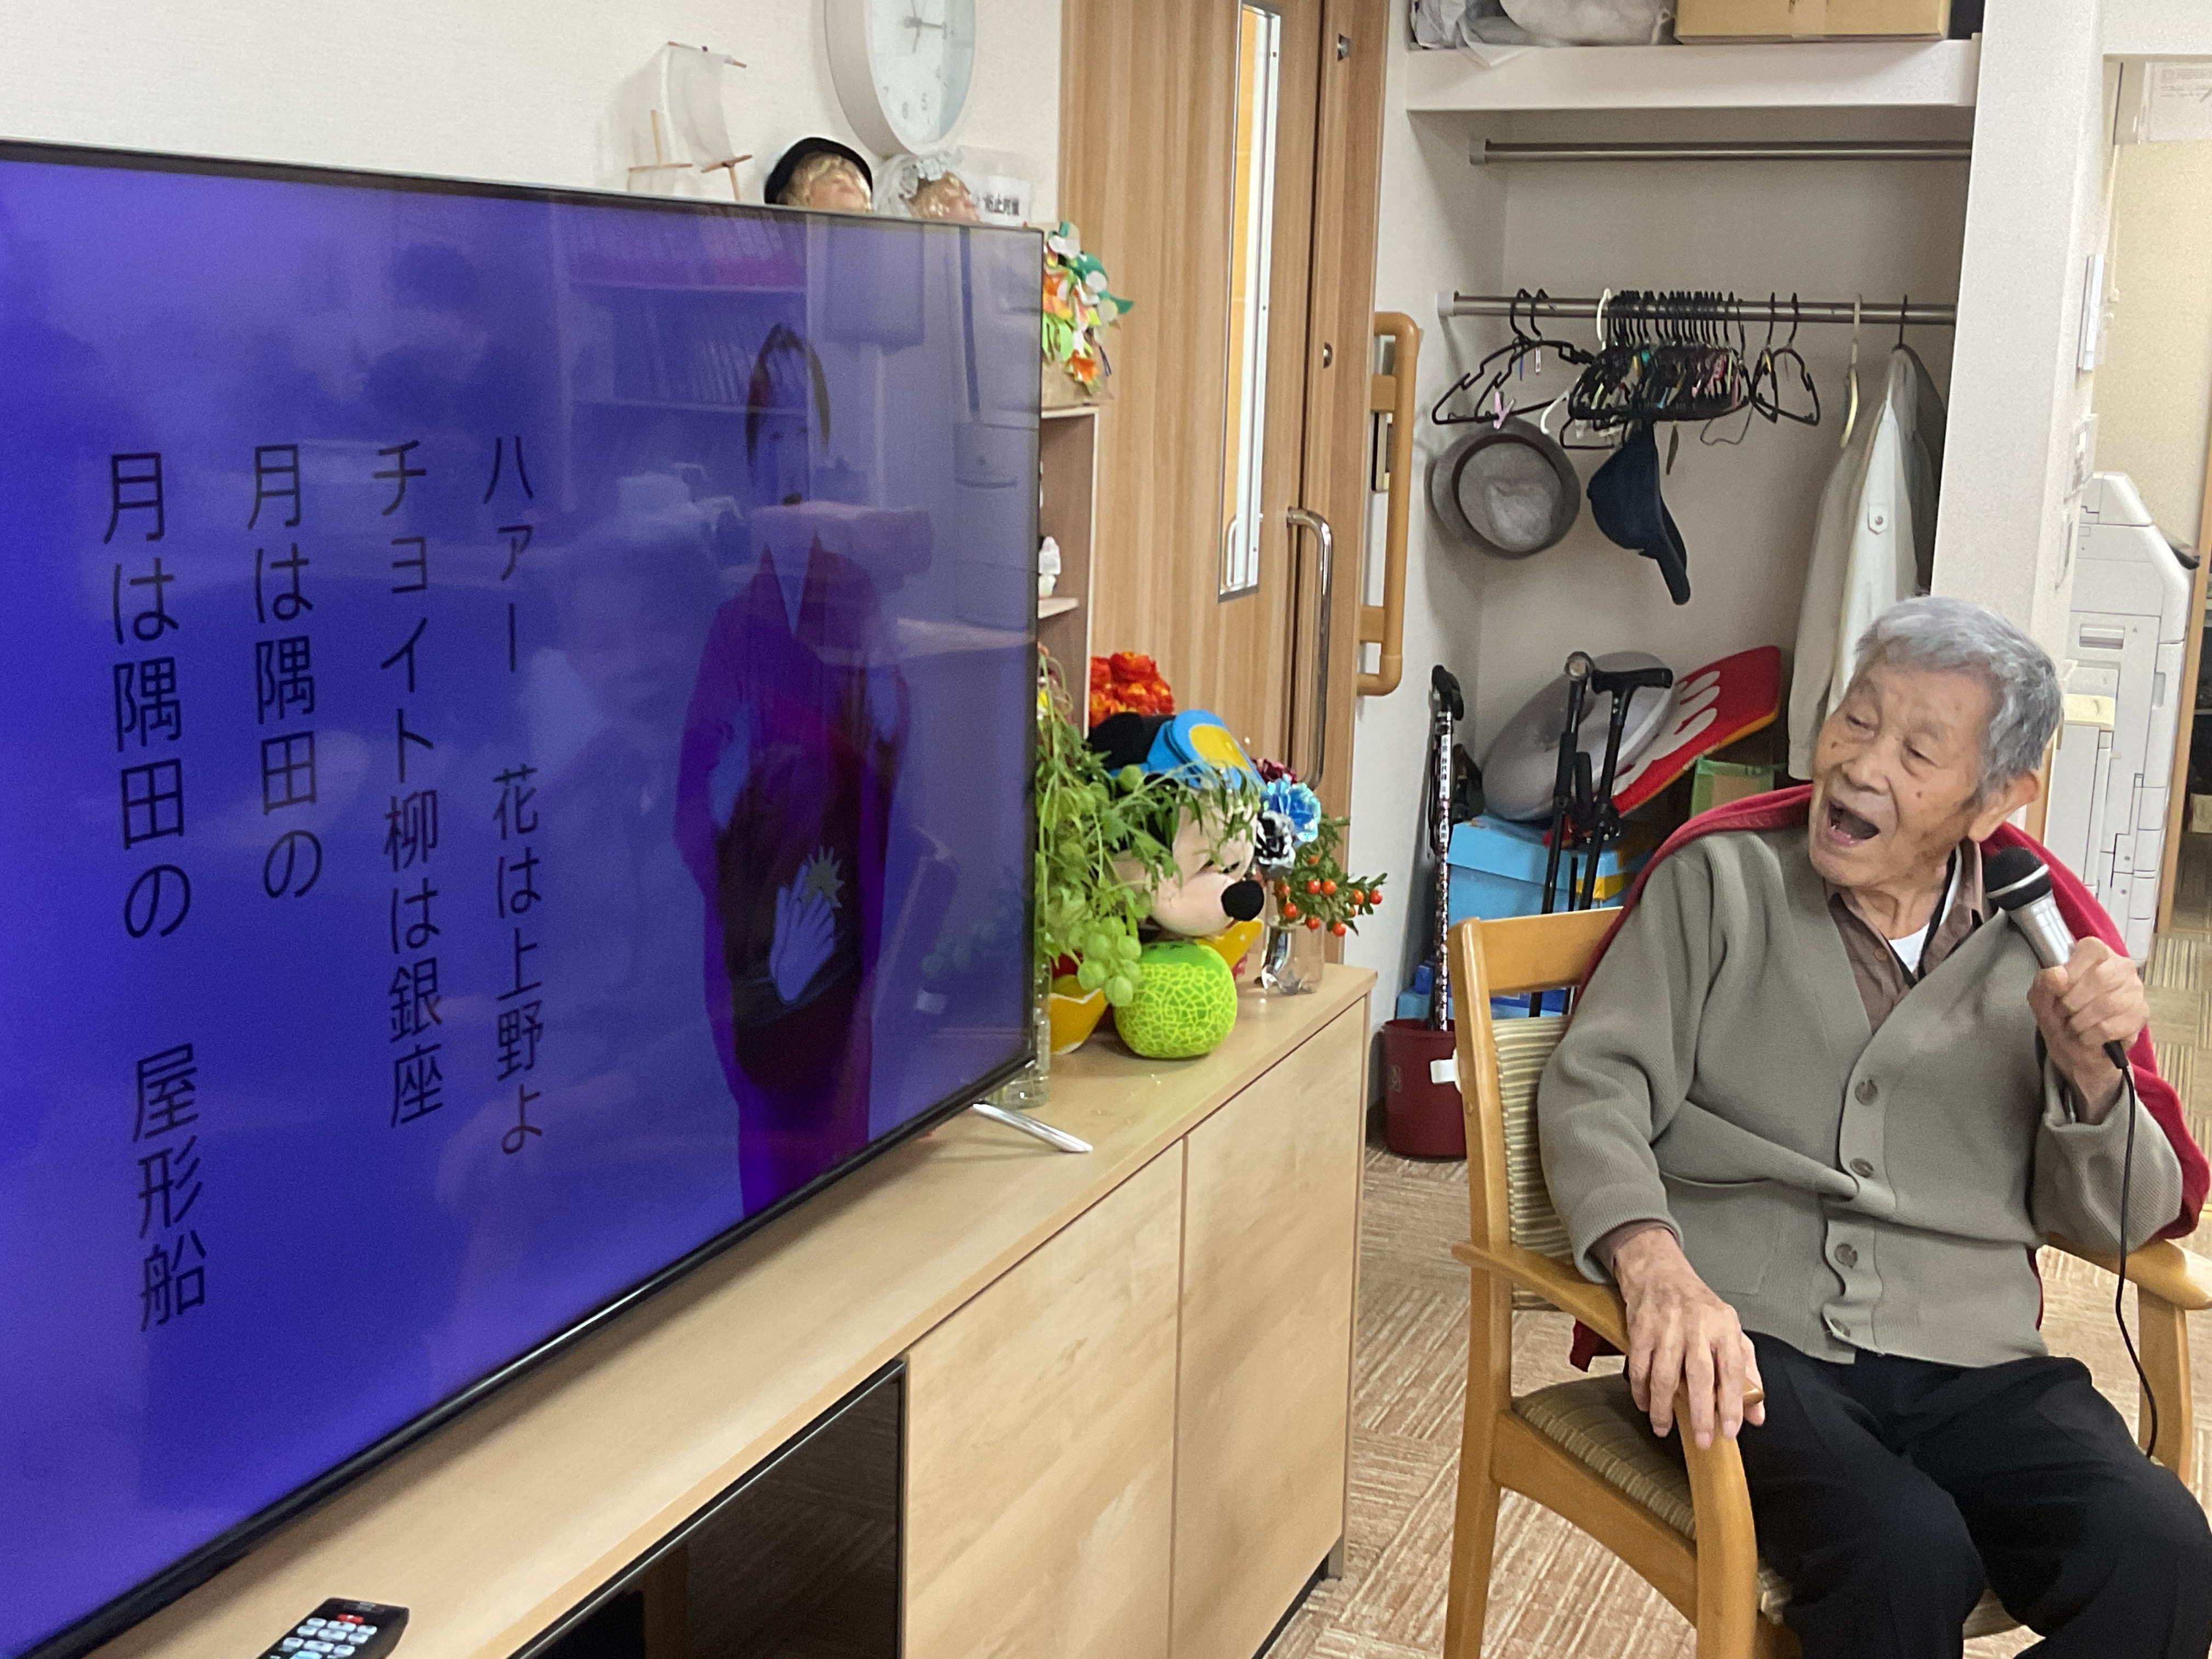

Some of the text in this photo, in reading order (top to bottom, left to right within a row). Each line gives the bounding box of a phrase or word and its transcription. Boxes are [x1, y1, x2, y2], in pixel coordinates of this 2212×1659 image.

[104, 452, 206, 1332] 月は隅田の 屋形船
[248, 444, 323, 899] 月は隅田の
[373, 439, 443, 1127] チョイト柳は銀座
[483, 435, 544, 1155] ハァー 花は上野よ
